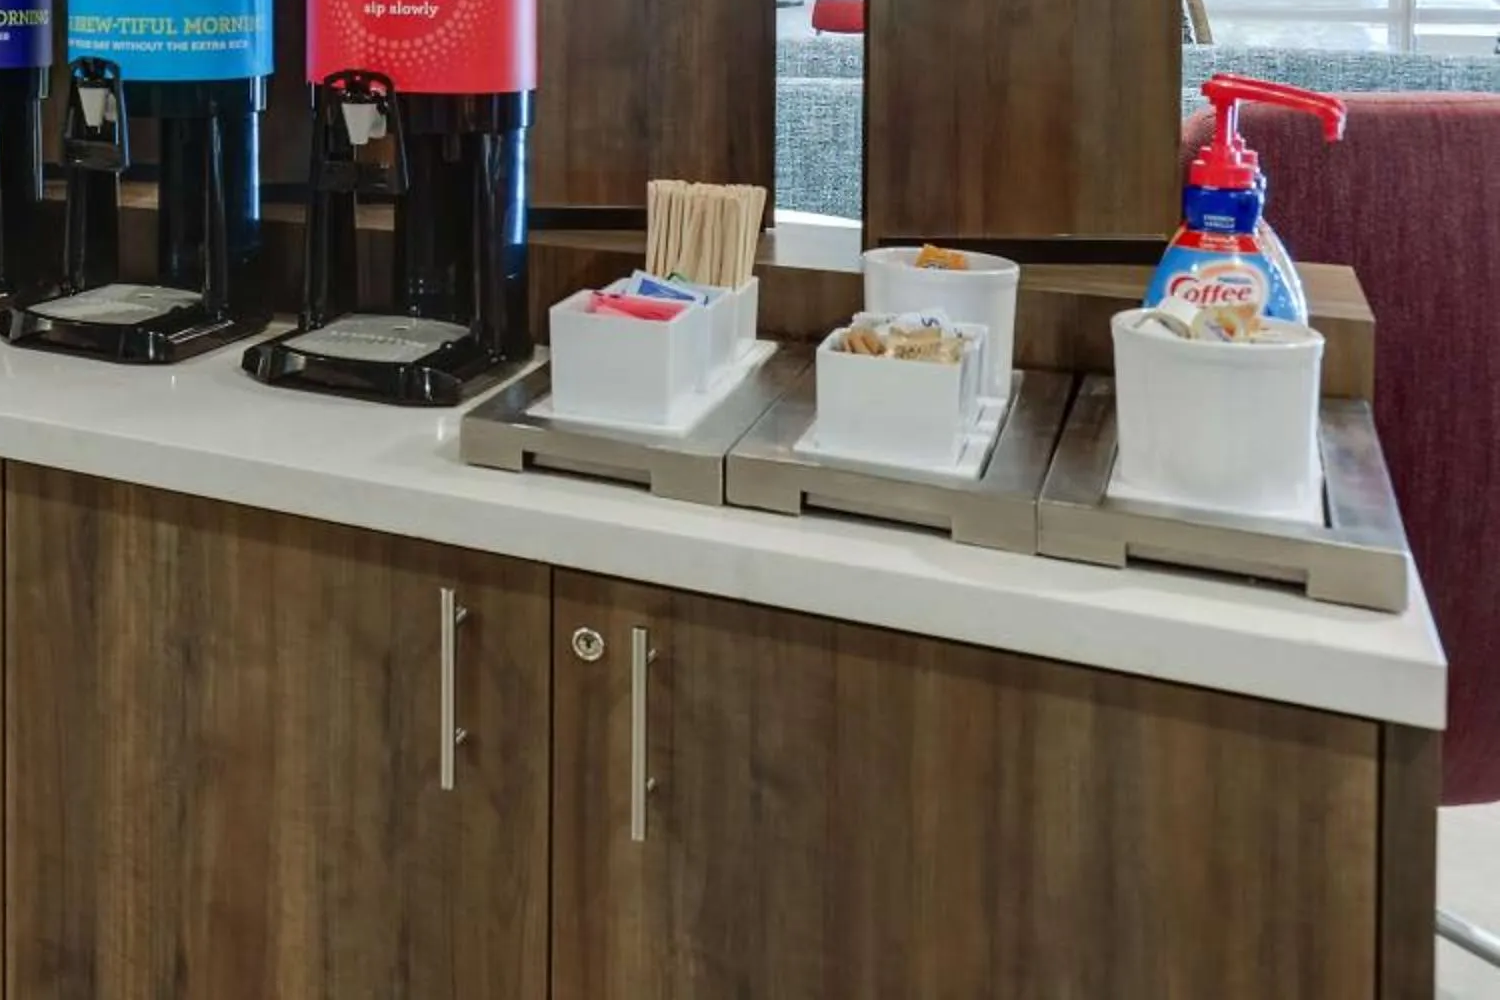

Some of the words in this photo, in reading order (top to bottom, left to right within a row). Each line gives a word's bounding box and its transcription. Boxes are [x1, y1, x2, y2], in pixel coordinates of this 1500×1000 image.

[363, 1, 386, 18] sip
[389, 0, 440, 19] slowly
[112, 40, 164, 52] WITHOUT
[166, 40, 189, 51] THE
[191, 40, 227, 51] EXTRA
[1169, 275, 1253, 305] Coffee
